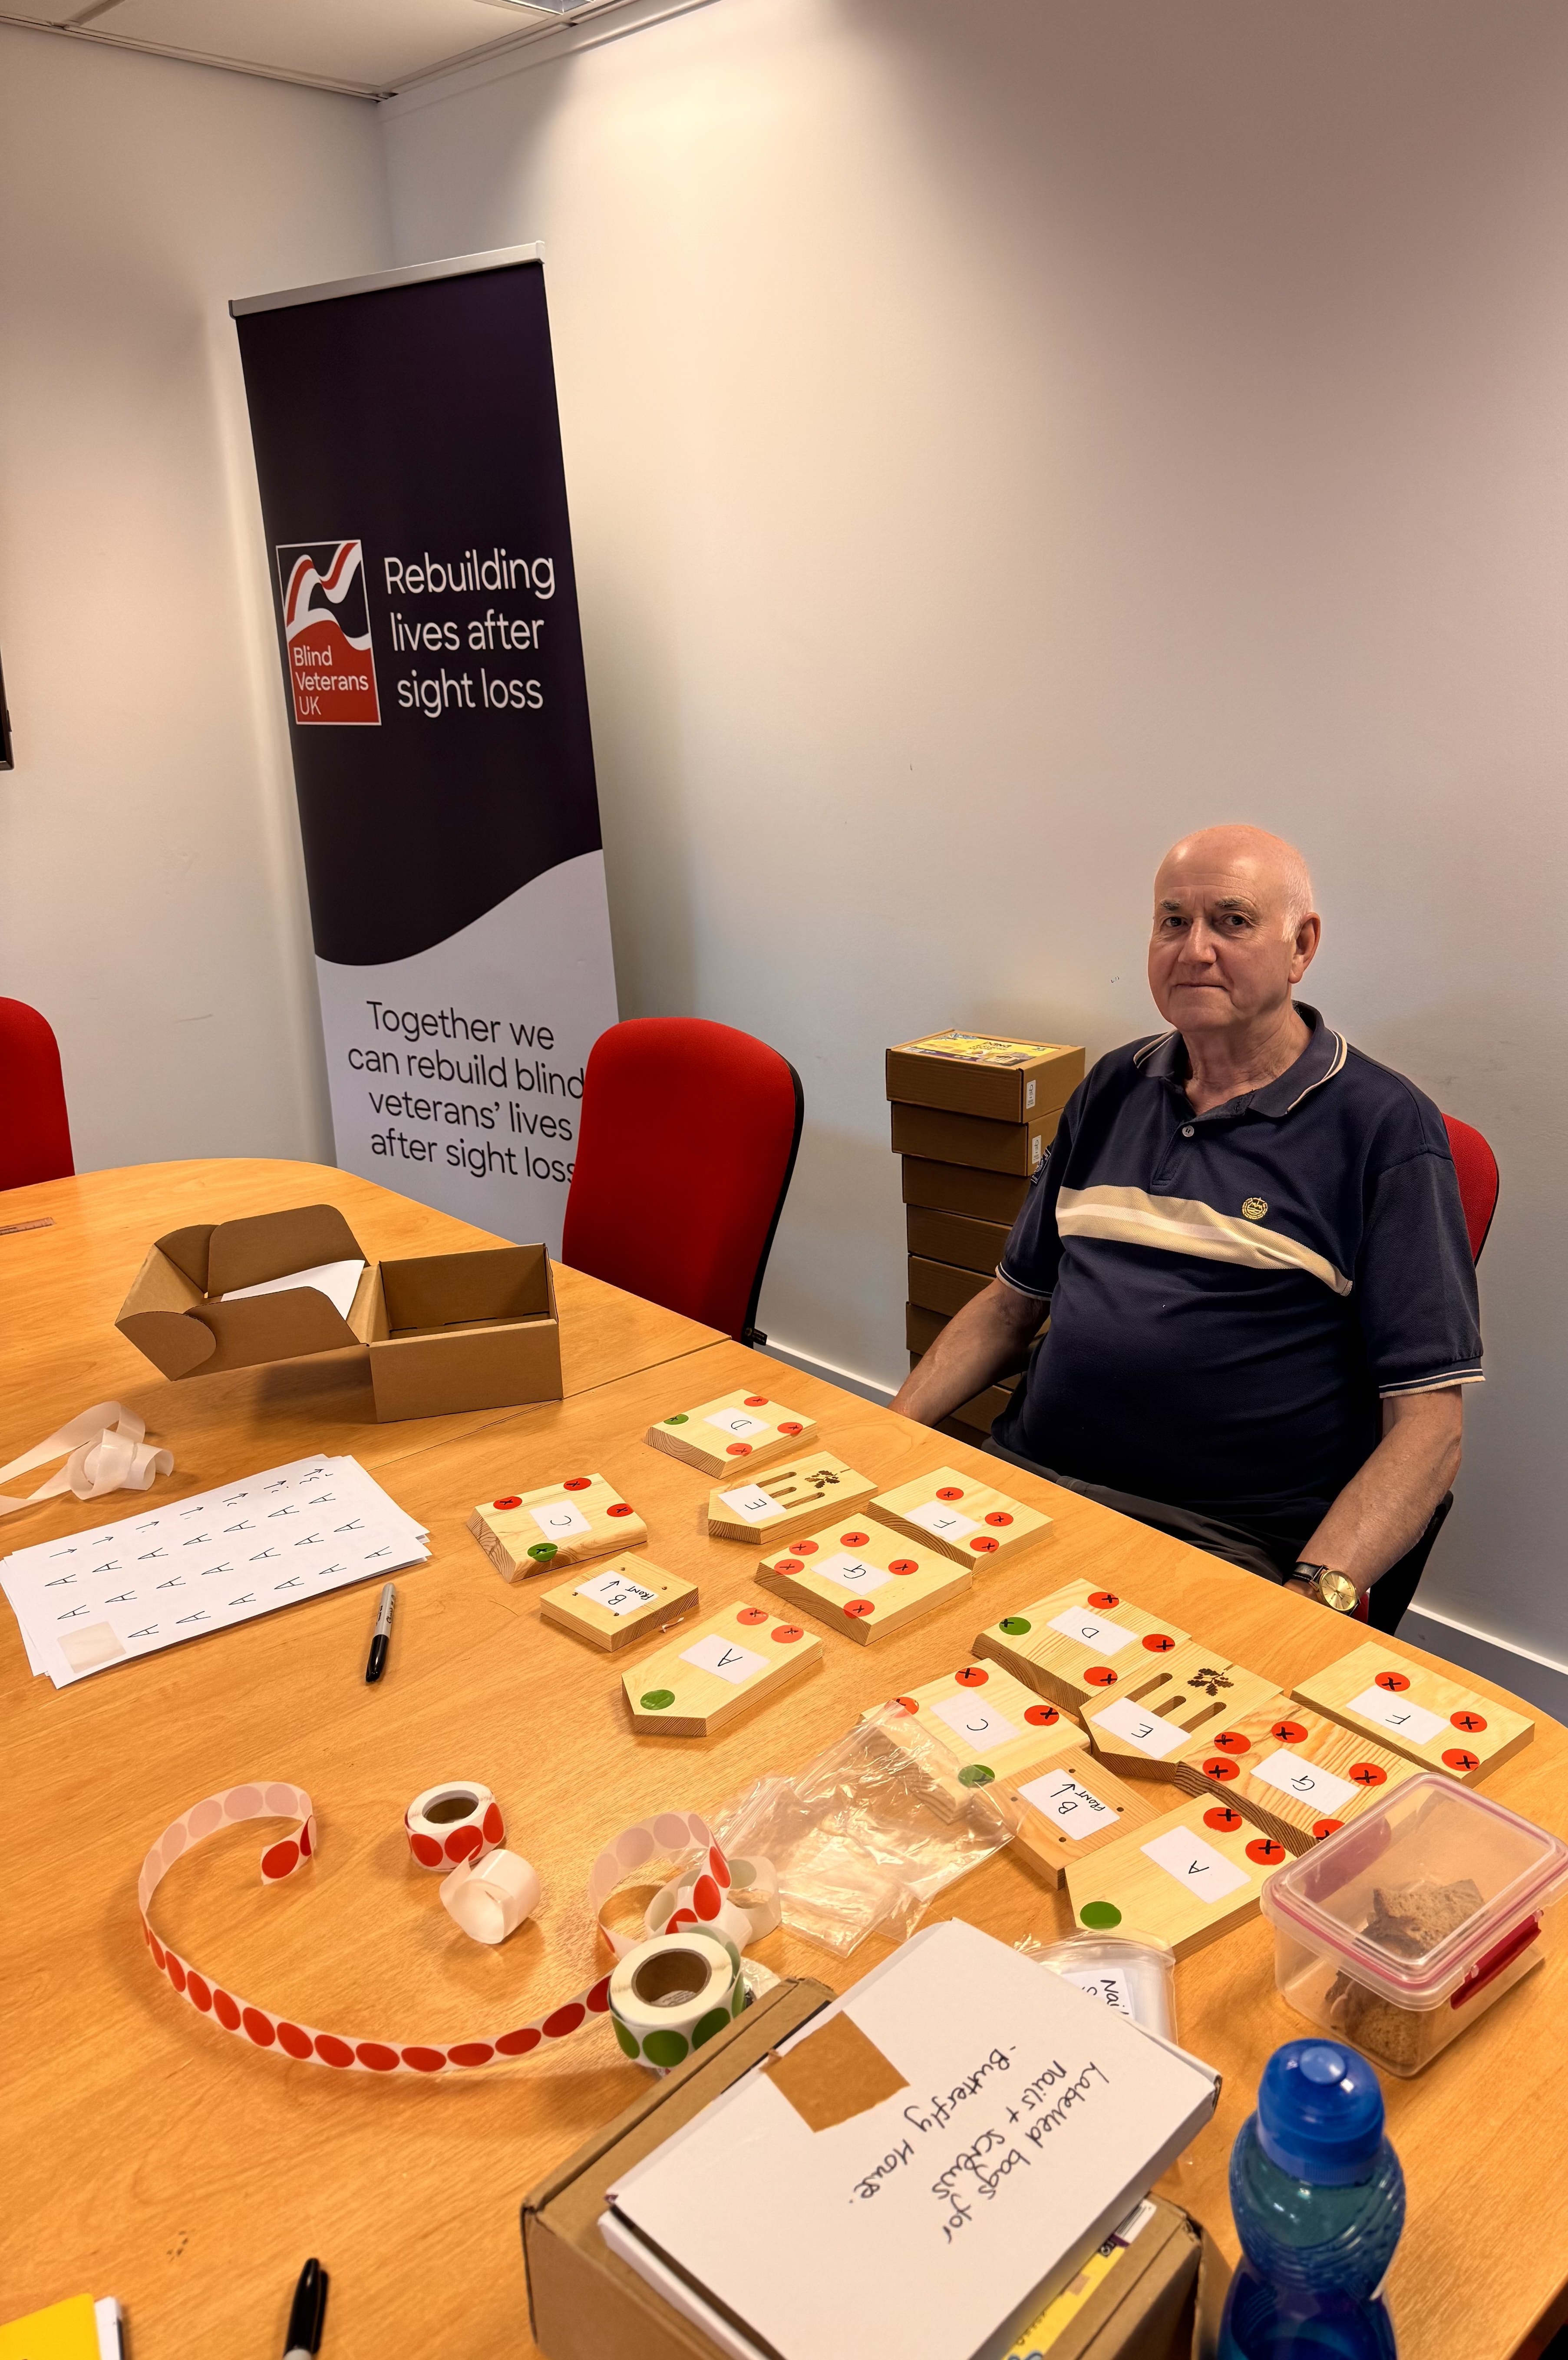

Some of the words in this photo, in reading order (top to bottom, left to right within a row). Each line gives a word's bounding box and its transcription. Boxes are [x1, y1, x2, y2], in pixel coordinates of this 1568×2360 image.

[384, 548, 555, 599] Rebuilding
[390, 612, 460, 651] lives
[468, 609, 544, 650] after
[294, 645, 333, 666] Blind
[295, 672, 369, 691] Veterans
[397, 669, 475, 718] sight
[481, 668, 544, 709] loss
[300, 696, 321, 715] UK
[366, 1001, 500, 1042] Together
[509, 1022, 554, 1050] we
[348, 1048, 399, 1075] can
[407, 1050, 507, 1088] rebuild
[515, 1058, 584, 1099] blind
[369, 1091, 500, 1129] veterans’
[509, 1101, 572, 1141] lives
[371, 1128, 437, 1162] after
[446, 1138, 518, 1177] sight
[731, 1420, 752, 1431] D
[309, 1493, 336, 1504] A
[745, 1499, 767, 1510] E
[268, 1506, 299, 1517] A
[224, 1520, 255, 1532] A
[334, 1519, 364, 1532] A
[550, 1515, 571, 1526] C
[933, 1520, 957, 1528] F
[183, 1534, 211, 1545] A
[294, 1533, 324, 1545] A
[138, 1548, 168, 1559] A
[249, 1548, 281, 1560] A
[364, 1547, 392, 1559] A
[92, 1560, 122, 1572] A
[201, 1563, 233, 1575] A
[319, 1564, 347, 1574] A
[843, 1564, 866, 1579] G
[45, 1574, 77, 1587] A
[156, 1577, 185, 1589] A
[274, 1577, 304, 1589] A
[105, 1591, 137, 1603] A
[229, 1593, 256, 1605] A
[625, 1586, 654, 1600] FRONT
[608, 1595, 626, 1605] B
[57, 1605, 90, 1620] A
[176, 1611, 211, 1623] A
[128, 1624, 159, 1638] A
[1082, 1627, 1099, 1639] D
[717, 1649, 743, 1667] A
[967, 1719, 988, 1731] C
[1385, 1715, 1411, 1725] F
[1131, 1723, 1154, 1738] E
[1291, 1775, 1315, 1791] G
[1074, 1791, 1106, 1811] FRONT
[1058, 1801, 1078, 1815] B
[1188, 1861, 1209, 1874] A
[1100, 1980, 1129, 2015] Nai
[1025, 2062, 1109, 2148] Labelled
[849, 2139, 914, 2203] House.
[974, 2149, 1031, 2200] bags
[943, 2193, 972, 2244] for
